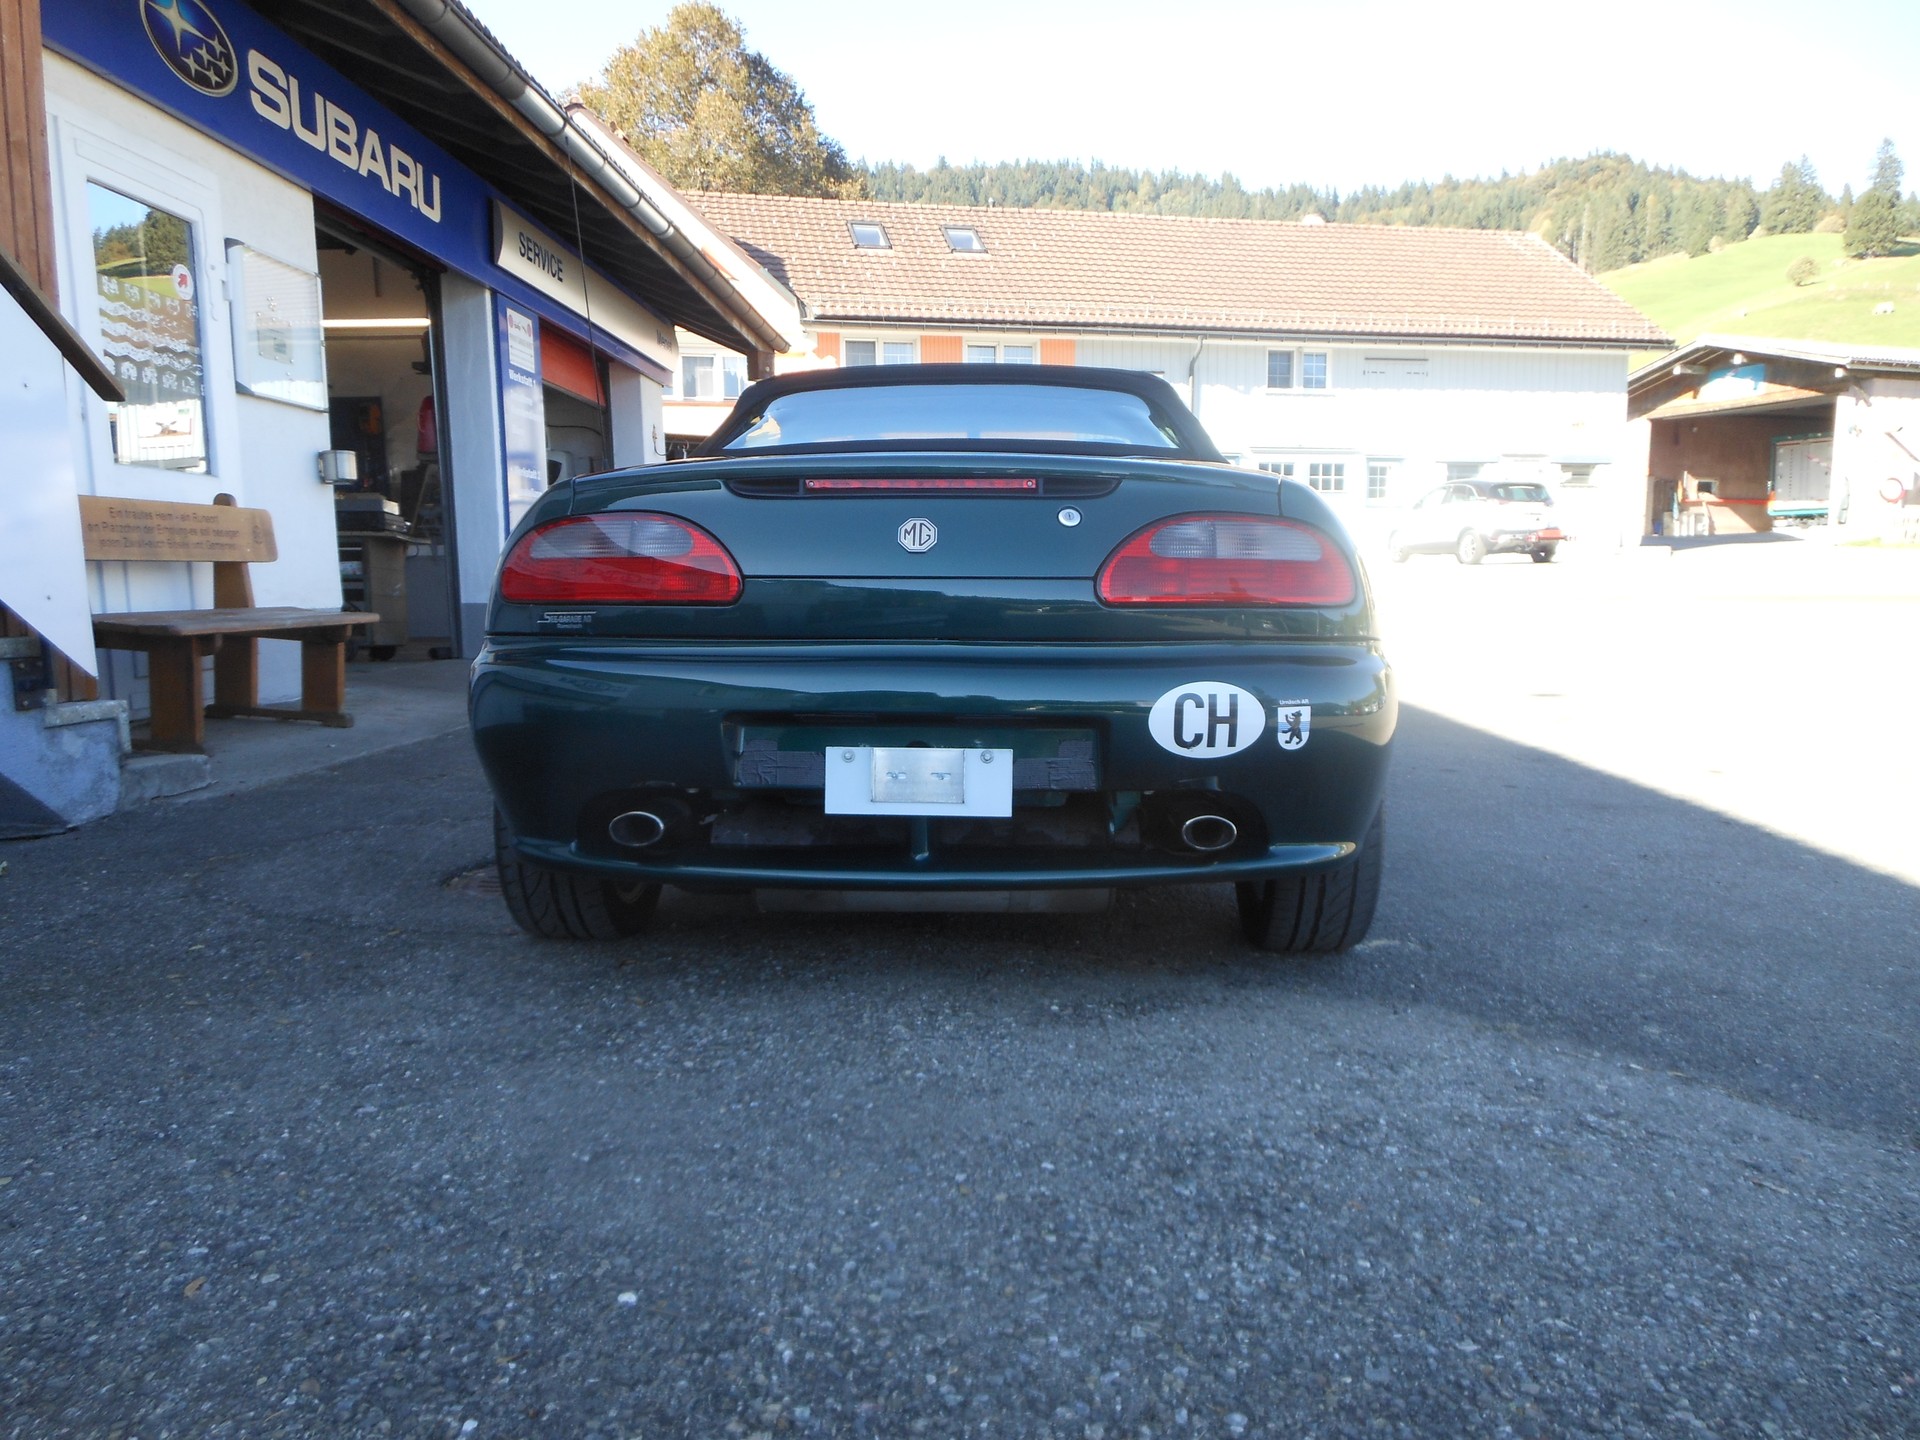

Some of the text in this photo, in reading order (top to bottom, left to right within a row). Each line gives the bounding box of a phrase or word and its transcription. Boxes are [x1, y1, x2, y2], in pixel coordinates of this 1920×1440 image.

[248, 49, 441, 223] SUBARU
[518, 231, 564, 283] SERVICE
[508, 368, 533, 388] Werkstatt
[903, 522, 931, 547] MG
[1173, 692, 1239, 750] CH
